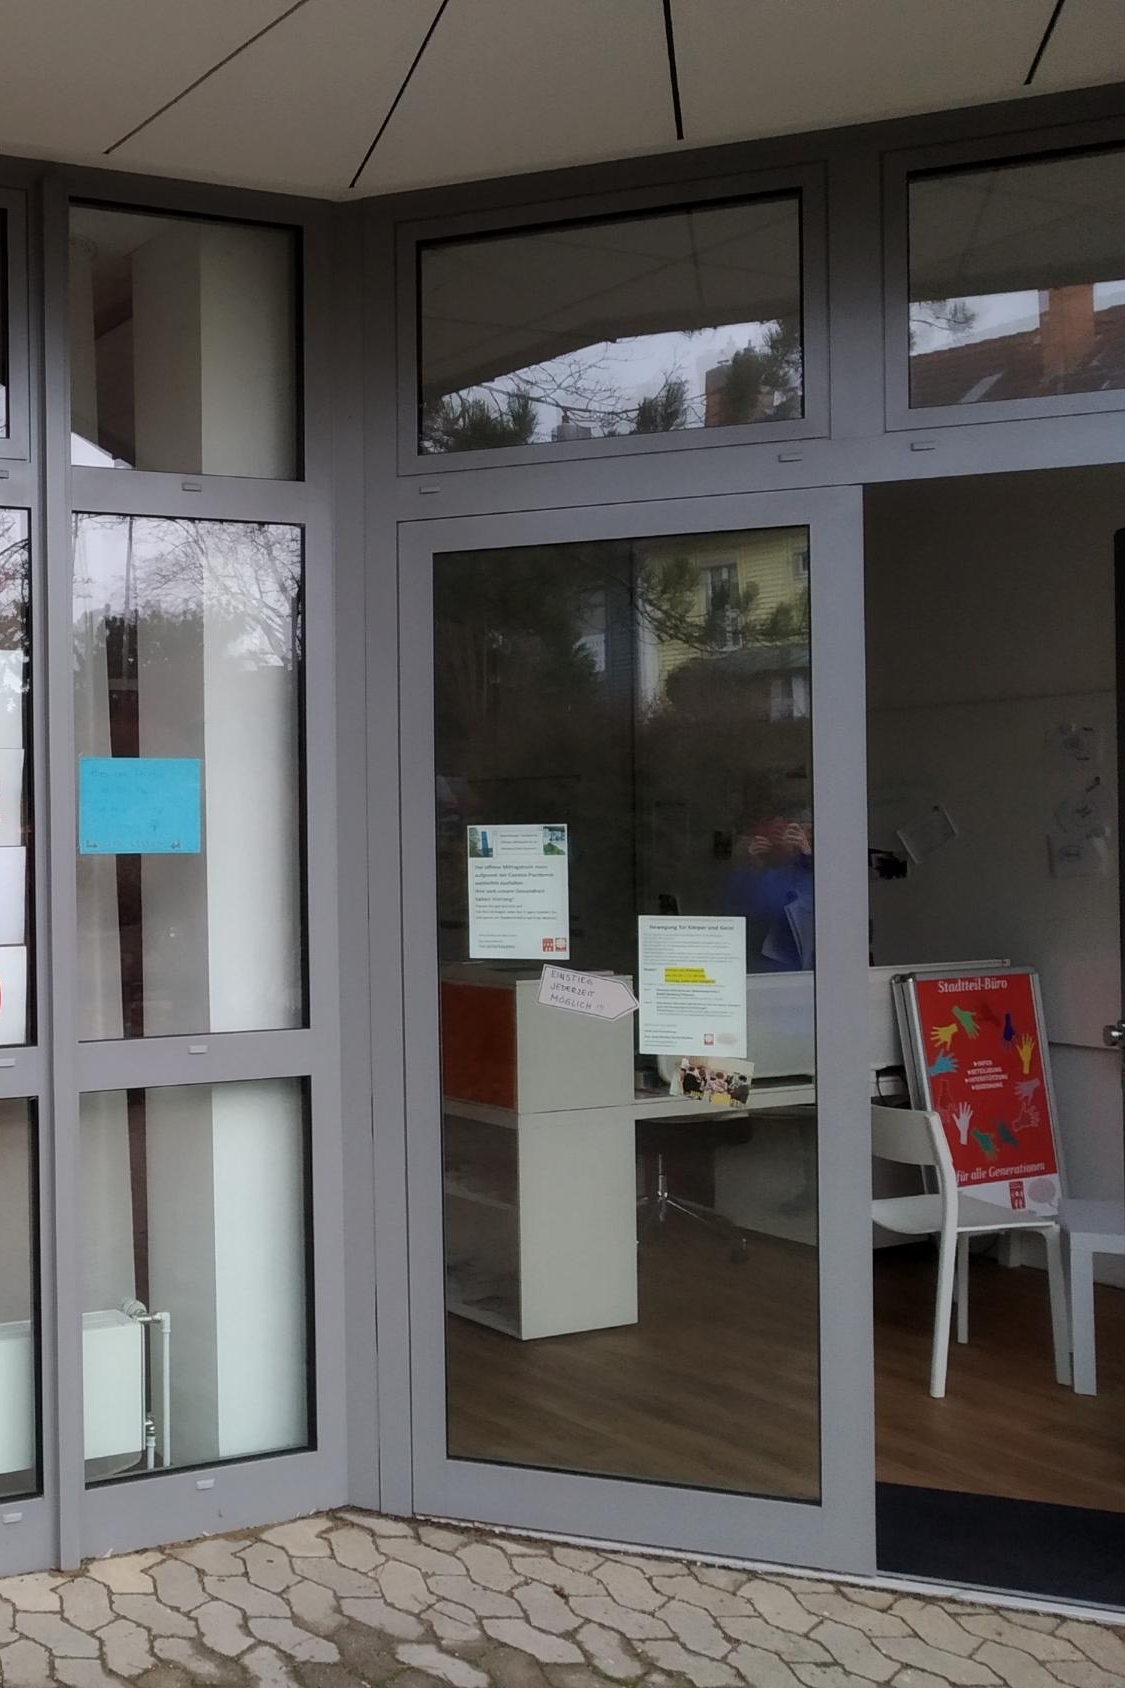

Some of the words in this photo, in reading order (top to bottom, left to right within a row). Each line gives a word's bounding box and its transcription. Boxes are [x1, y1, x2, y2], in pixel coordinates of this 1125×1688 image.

[550, 970, 594, 985] EINSTIEG
[938, 977, 1008, 993] Stadtteil-Büro
[550, 983, 595, 997] JEDERZEIT
[957, 1169, 969, 1184] für
[971, 1167, 987, 1180] alle
[989, 1162, 1046, 1178] Generationen
